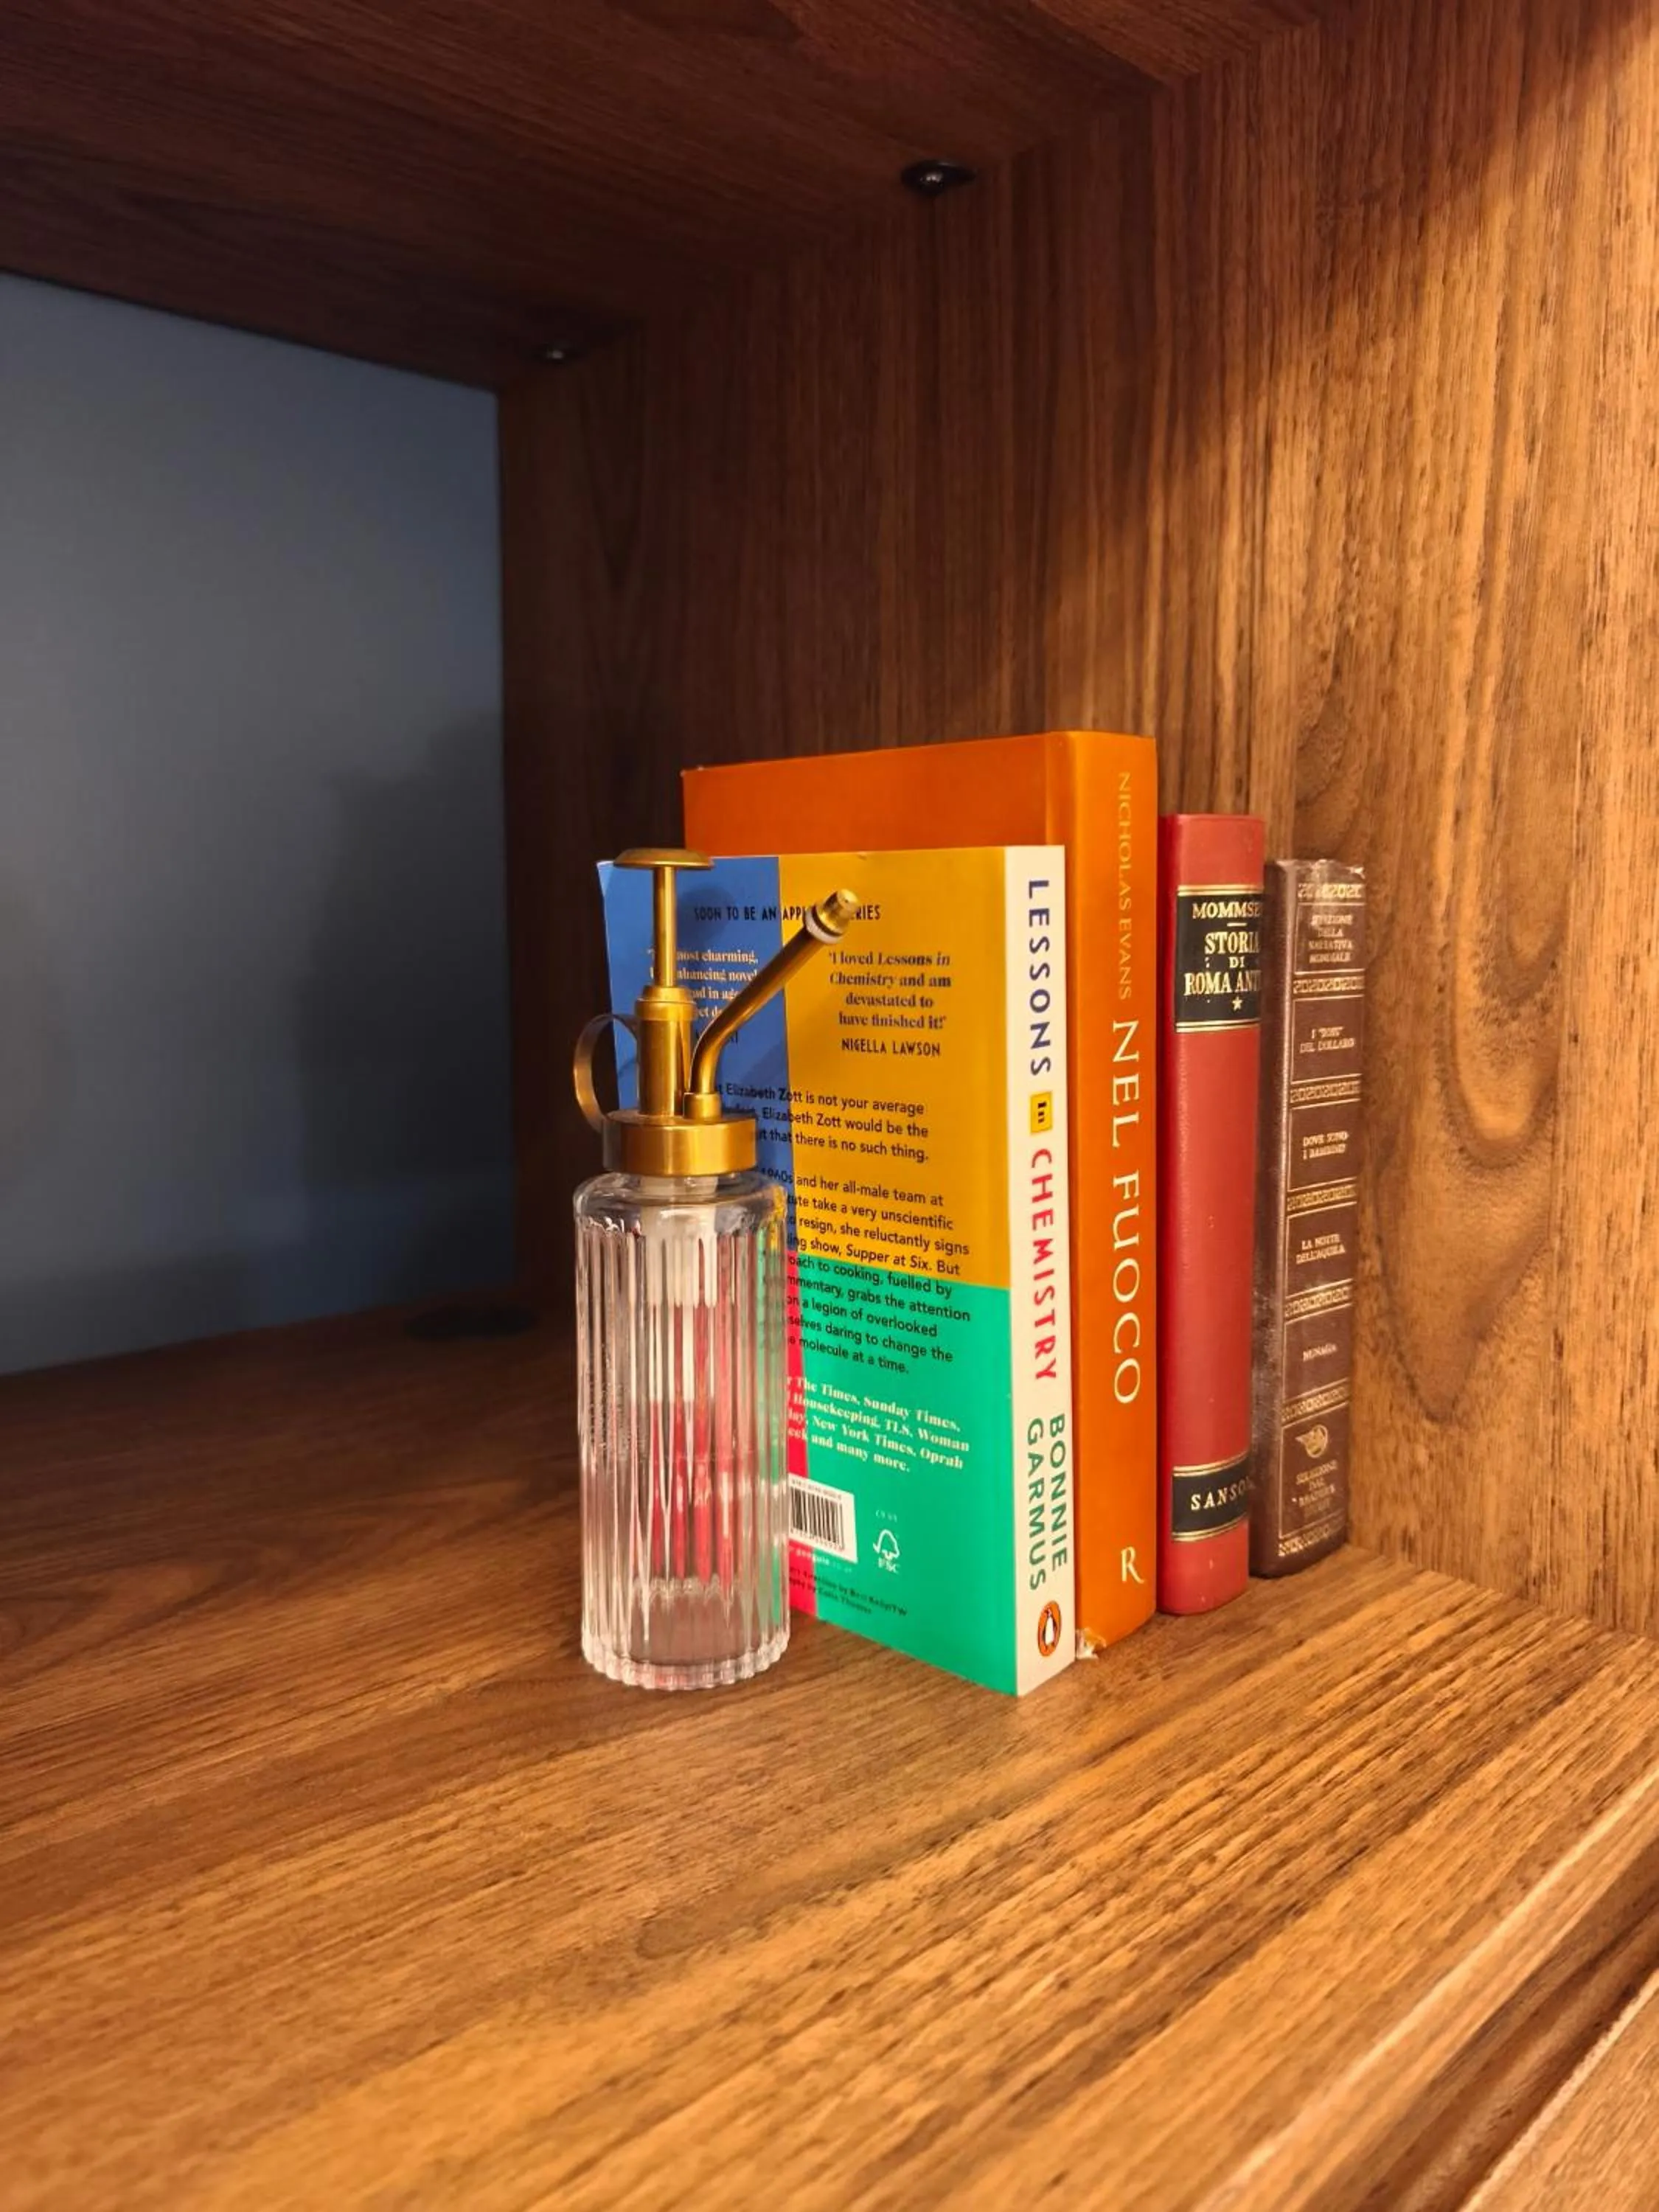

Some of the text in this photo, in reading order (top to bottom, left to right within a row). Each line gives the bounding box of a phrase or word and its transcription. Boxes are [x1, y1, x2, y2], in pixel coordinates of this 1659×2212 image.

[1118, 771, 1132, 1001] NICHOLAS EVANS
[695, 906, 722, 921] SOON
[727, 907, 739, 920] TO
[744, 907, 756, 921] BE
[762, 906, 777, 921] AN
[854, 905, 881, 920] RIES
[1192, 901, 1263, 919] MOMMSE
[702, 950, 759, 964] charming,
[841, 951, 873, 965] loved
[878, 952, 933, 965] Lessons
[936, 952, 950, 966] in
[1204, 931, 1260, 955] STORIA
[728, 970, 758, 982] novel
[1029, 880, 1051, 1076] LESSONS
[1229, 956, 1245, 968] DI
[709, 987, 719, 999] in
[830, 972, 951, 989] Chemistry and am
[1183, 971, 1233, 996] ROMA
[846, 992, 933, 1008] devastated to
[839, 1011, 868, 1026] have
[872, 1014, 925, 1029] finished
[841, 1037, 941, 1057] NIGELLA LAWSON
[727, 1082, 775, 1100] Elizabeth
[779, 1088, 802, 1103] Zott
[806, 1091, 815, 1104] is
[818, 1093, 838, 1107] not
[841, 1097, 869, 1111] your
[872, 1101, 925, 1118] average
[762, 1107, 813, 1125] Elizabeth
[817, 1114, 841, 1128] Zott
[845, 1118, 882, 1133] would
[887, 1121, 902, 1135] be
[907, 1123, 928, 1138] the
[769, 1127, 792, 1144] that
[796, 1132, 824, 1147] there
[829, 1135, 838, 1149] is
[841, 1138, 856, 1152] no
[860, 1141, 887, 1155] such
[891, 1143, 929, 1163] thing.
[796, 1175, 816, 1188] and
[820, 1176, 839, 1192] her
[843, 1180, 889, 1199] all-male
[893, 1189, 926, 1204] team
[930, 1194, 944, 1206] at
[813, 1197, 837, 1212] take
[841, 1203, 847, 1213] a
[852, 1206, 877, 1222] very
[881, 1211, 953, 1231] unscientific
[1112, 1020, 1141, 1404] NEL FUOCO
[799, 1217, 837, 1236] resign,
[840, 1222, 860, 1237] she
[863, 1227, 929, 1250] reluctantly
[934, 1239, 970, 1256] signs
[811, 1237, 841, 1256] show,
[846, 1243, 889, 1265] Supper
[893, 1253, 905, 1267] at
[910, 1255, 932, 1272] Six.
[937, 1260, 960, 1276] But
[1031, 1148, 1057, 1380] CHEMISTRY
[818, 1260, 830, 1273] to
[833, 1262, 883, 1286] cooking,
[887, 1271, 931, 1293] fuelled
[936, 1279, 953, 1299] by
[802, 1298, 809, 1308] a
[812, 1298, 847, 1316] legion
[850, 1307, 863, 1320] of
[866, 1312, 938, 1338] overlooked
[848, 1288, 881, 1305] grabs
[885, 1293, 905, 1310] the
[909, 1300, 971, 1321] attention
[799, 1335, 849, 1359] molecule
[852, 1350, 864, 1363] at
[868, 1355, 875, 1365] a
[878, 1354, 909, 1374] time.
[825, 1322, 863, 1345] daring
[866, 1332, 878, 1346] to
[882, 1336, 927, 1359] change
[931, 1345, 953, 1363] the
[796, 1376, 817, 1393] The
[821, 1383, 860, 1406] Times,
[863, 1396, 911, 1420] Sunday
[916, 1409, 961, 1432] Times,
[812, 1433, 833, 1448] and
[837, 1441, 869, 1462] many
[873, 1452, 910, 1472] more.
[813, 1416, 838, 1432] New
[841, 1424, 870, 1442] York
[920, 1447, 963, 1470] Oprah
[918, 1427, 970, 1453] Woman
[1027, 1417, 1046, 1591] GARMUS
[1049, 1413, 1068, 1572] BONNIE
[1191, 1475, 1255, 1511] SANSO
[1121, 1545, 1144, 1584] R
